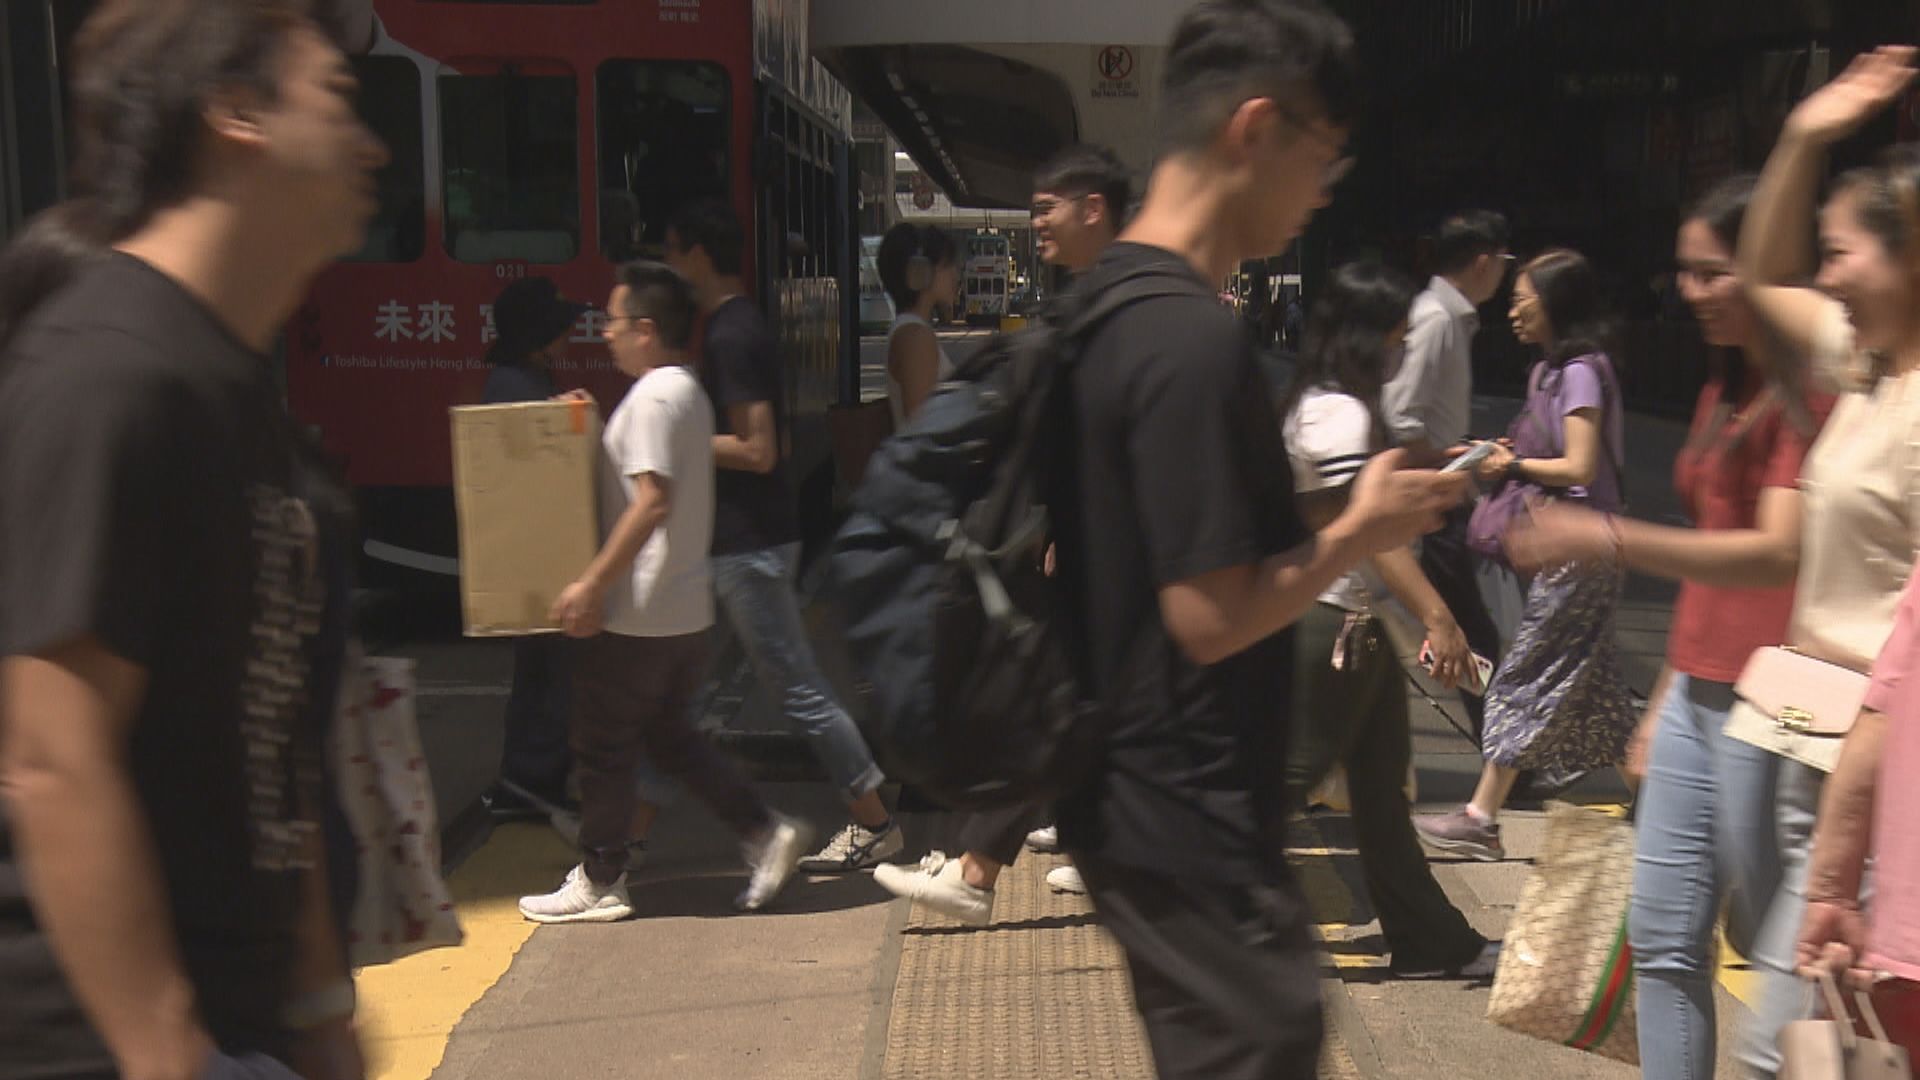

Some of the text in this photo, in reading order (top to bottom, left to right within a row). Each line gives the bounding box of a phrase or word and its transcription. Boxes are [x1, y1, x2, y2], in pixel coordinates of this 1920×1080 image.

[374, 299, 457, 344] 未來
[335, 354, 376, 368] Toshiba
[379, 354, 427, 371] Lifestyle
[430, 356, 462, 372] Hong
